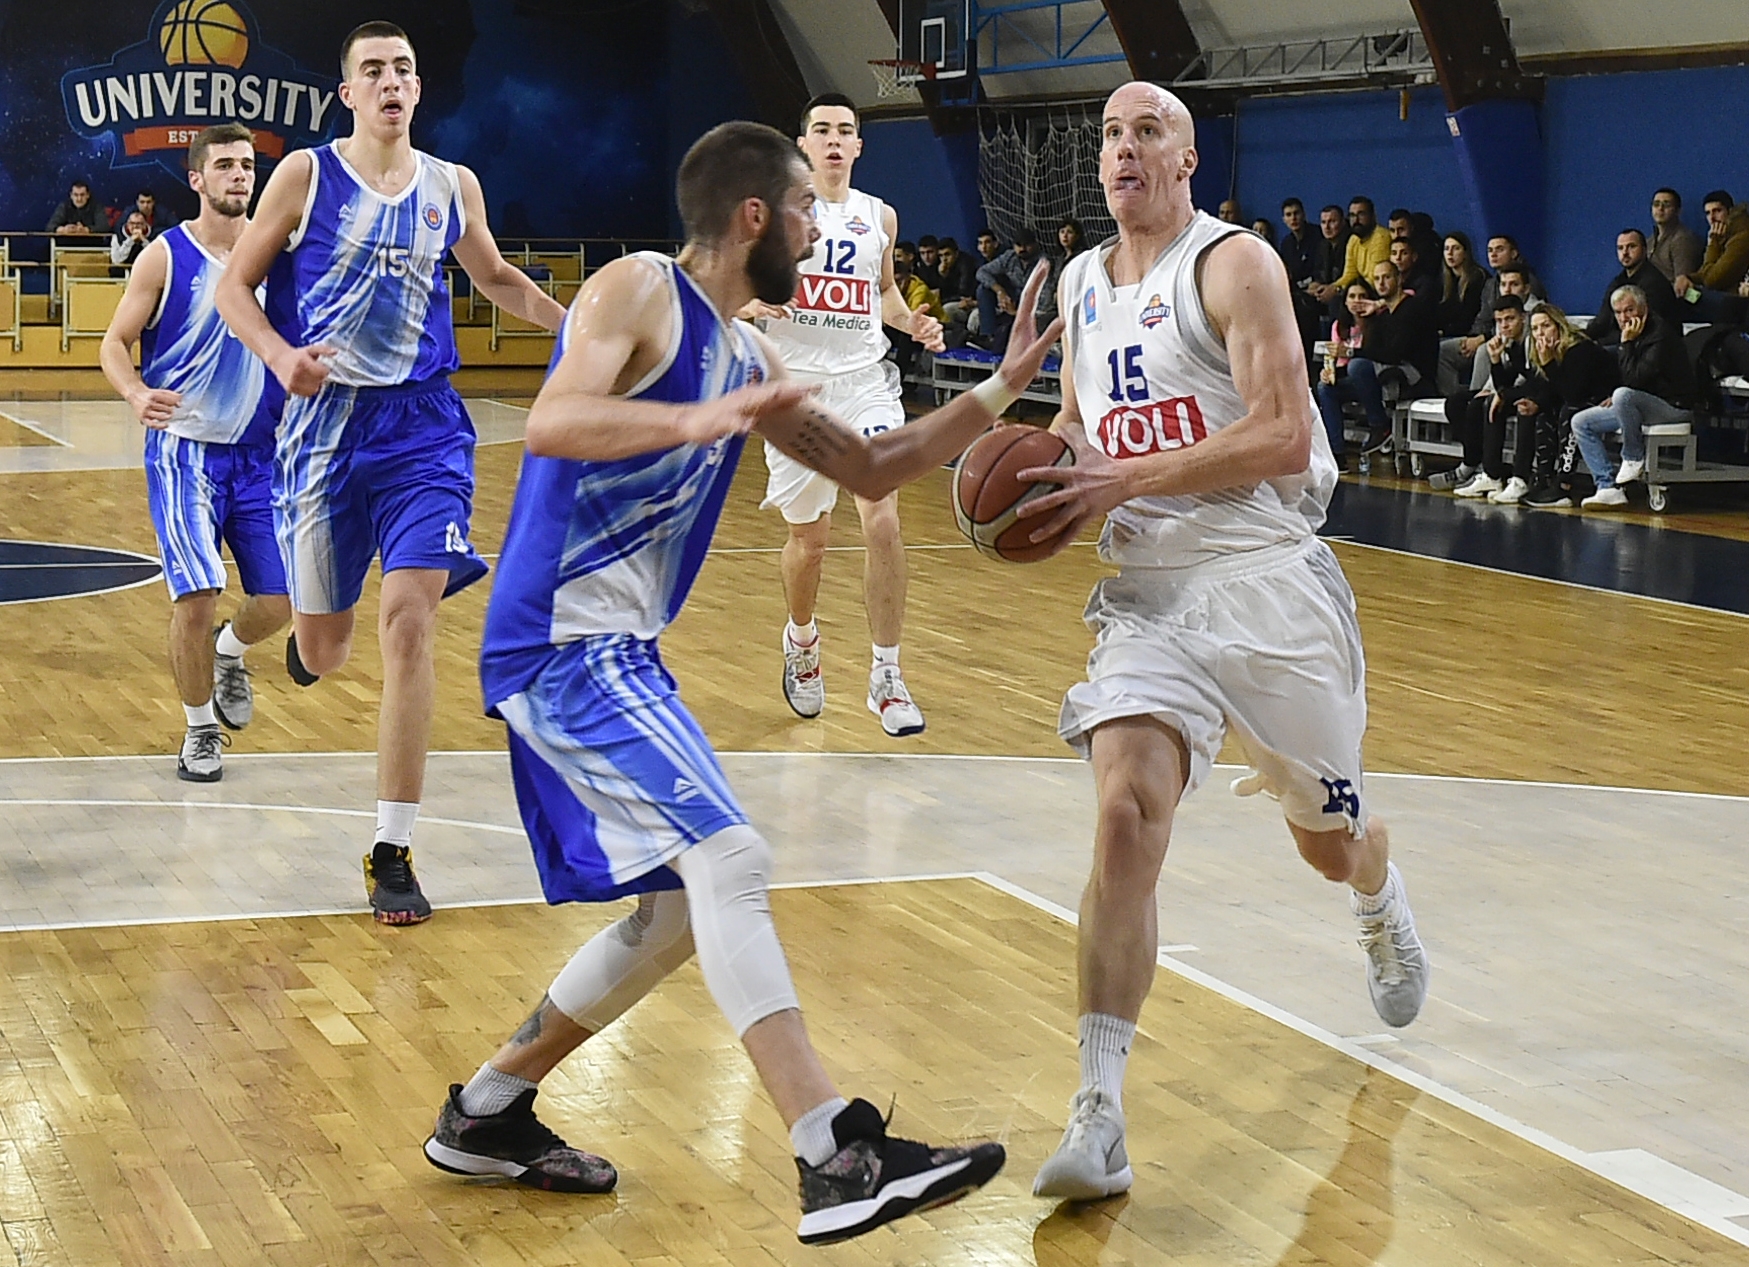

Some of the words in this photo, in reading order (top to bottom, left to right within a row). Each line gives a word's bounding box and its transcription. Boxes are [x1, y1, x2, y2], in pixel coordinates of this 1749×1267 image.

[75, 71, 335, 132] UNIVERSITY
[167, 130, 200, 144] EST
[377, 247, 409, 278] 15
[823, 238, 856, 275] 12
[802, 277, 869, 312] VOLI
[792, 310, 818, 326] Tea
[1108, 344, 1150, 402] 15
[1105, 401, 1195, 457] VOLI
[1562, 432, 1578, 473] adidas
